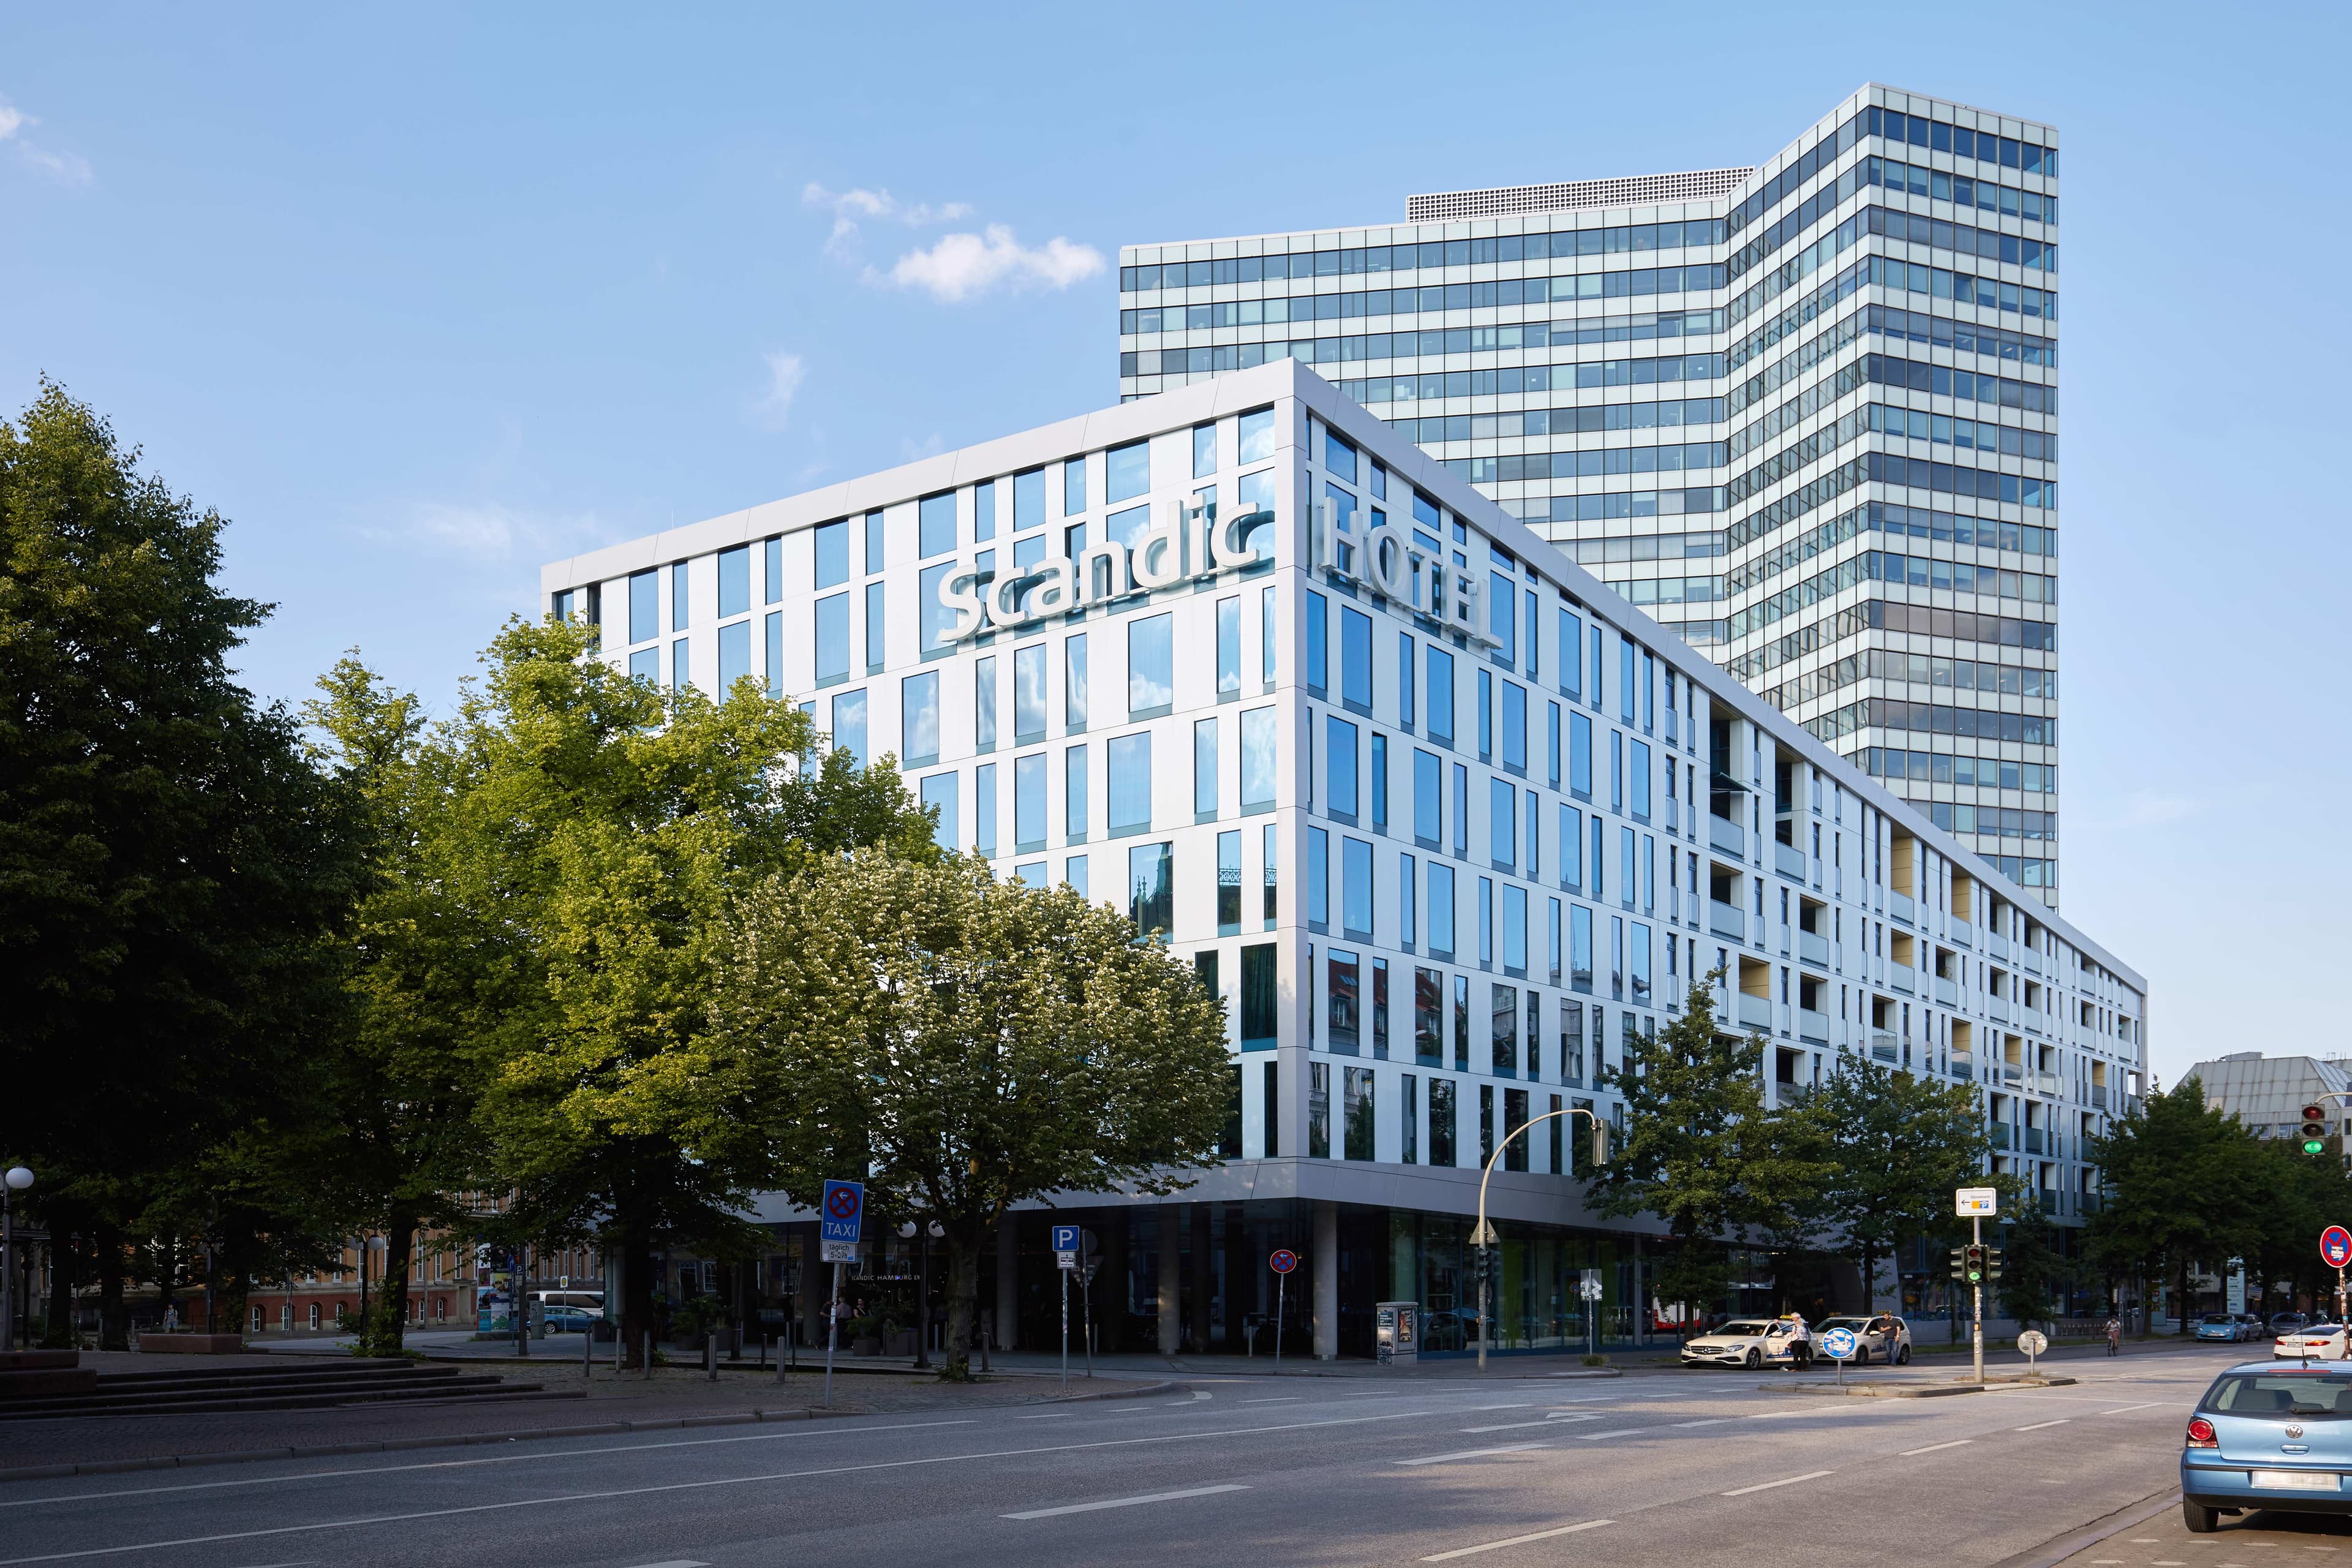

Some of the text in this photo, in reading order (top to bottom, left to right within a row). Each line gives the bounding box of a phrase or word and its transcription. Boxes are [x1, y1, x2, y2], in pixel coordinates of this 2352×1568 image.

[938, 492, 1260, 642] Scandic
[1324, 496, 1503, 649] HOTEL
[826, 1222, 856, 1237] TAXI
[1059, 1229, 1073, 1248] P
[829, 1243, 850, 1252] täglich
